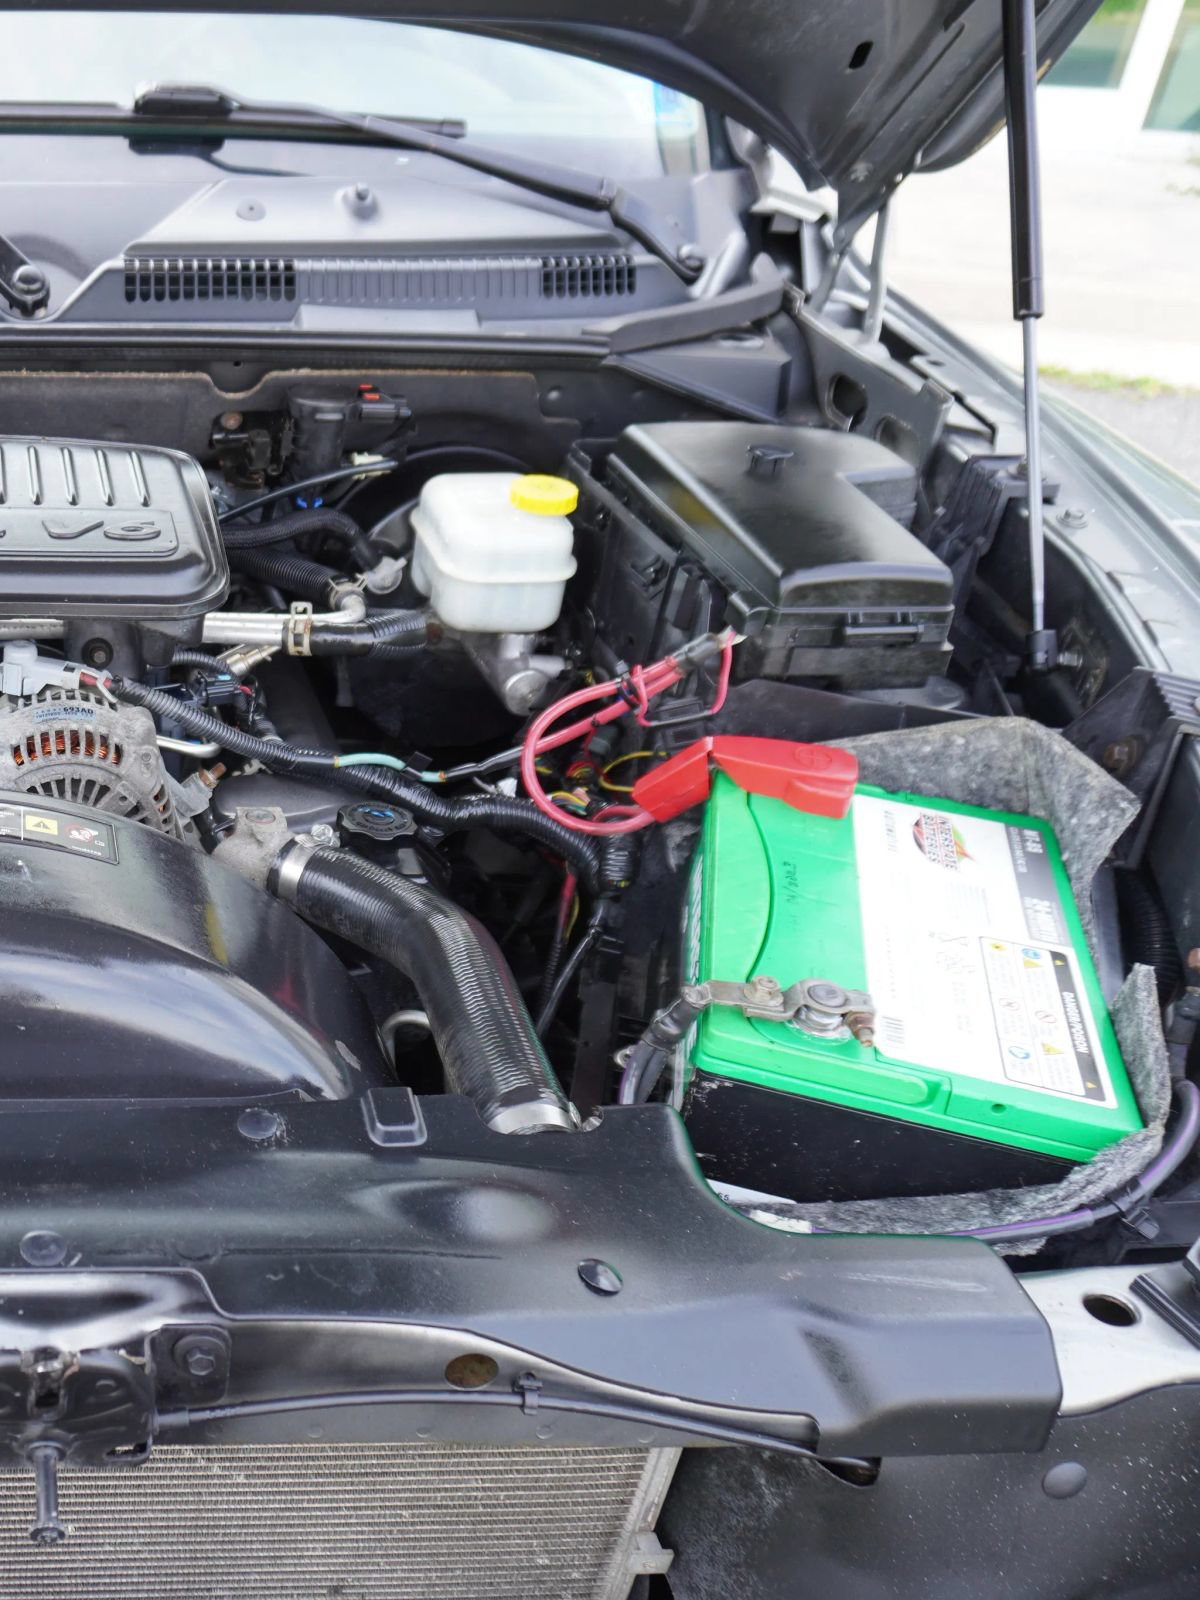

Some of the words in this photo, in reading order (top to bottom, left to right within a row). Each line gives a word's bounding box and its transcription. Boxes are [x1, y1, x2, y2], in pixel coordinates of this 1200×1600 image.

[41, 519, 161, 541] V6
[921, 813, 942, 863] BATTERIES
[939, 816, 960, 870] INTERSTATE
[1062, 991, 1089, 1054] DANGER/POISON
